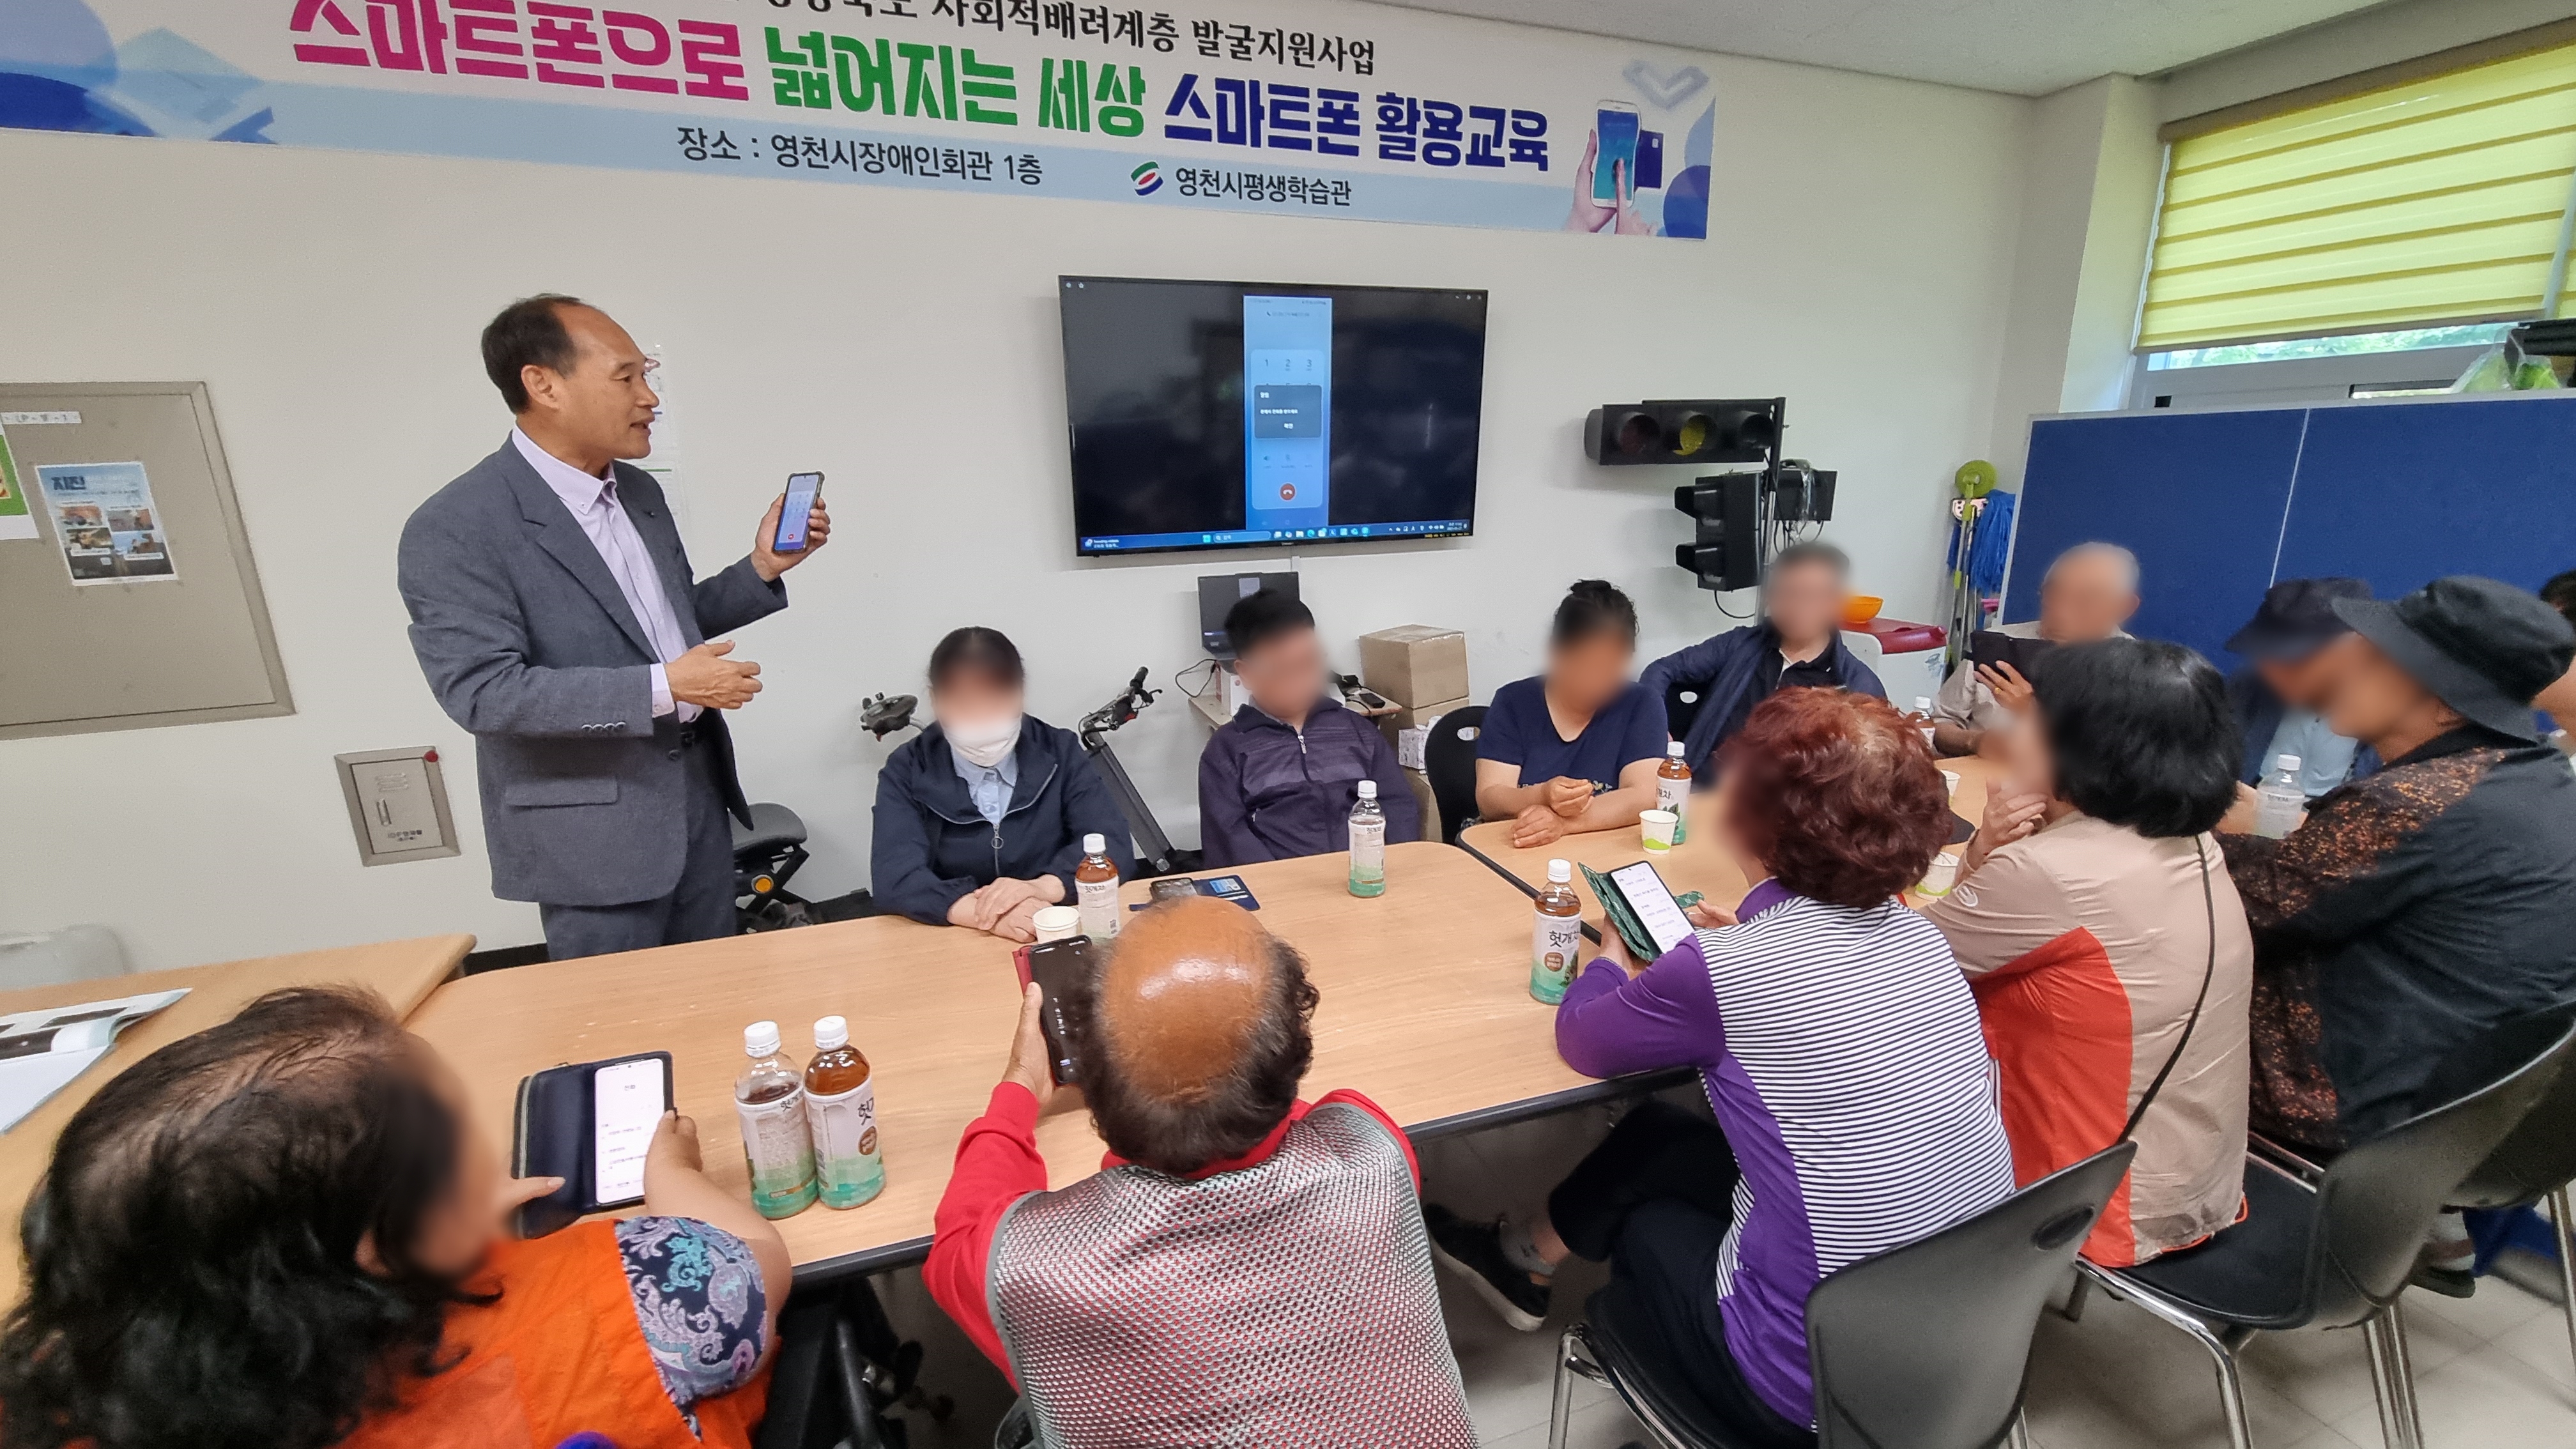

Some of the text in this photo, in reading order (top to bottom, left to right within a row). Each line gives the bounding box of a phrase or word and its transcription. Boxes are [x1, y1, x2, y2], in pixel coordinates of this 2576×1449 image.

[931, 0, 1375, 77] 사회적배려계층 발굴지원사업
[289, 0, 1549, 172] 스마트폰으로 넓어지는 세상 스마트폰 활용교육
[677, 126, 741, 162] 장소
[770, 134, 993, 182] 영천시장애인회관
[1004, 154, 1043, 185] 1층
[1175, 167, 1352, 207] 영천시평생학습관
